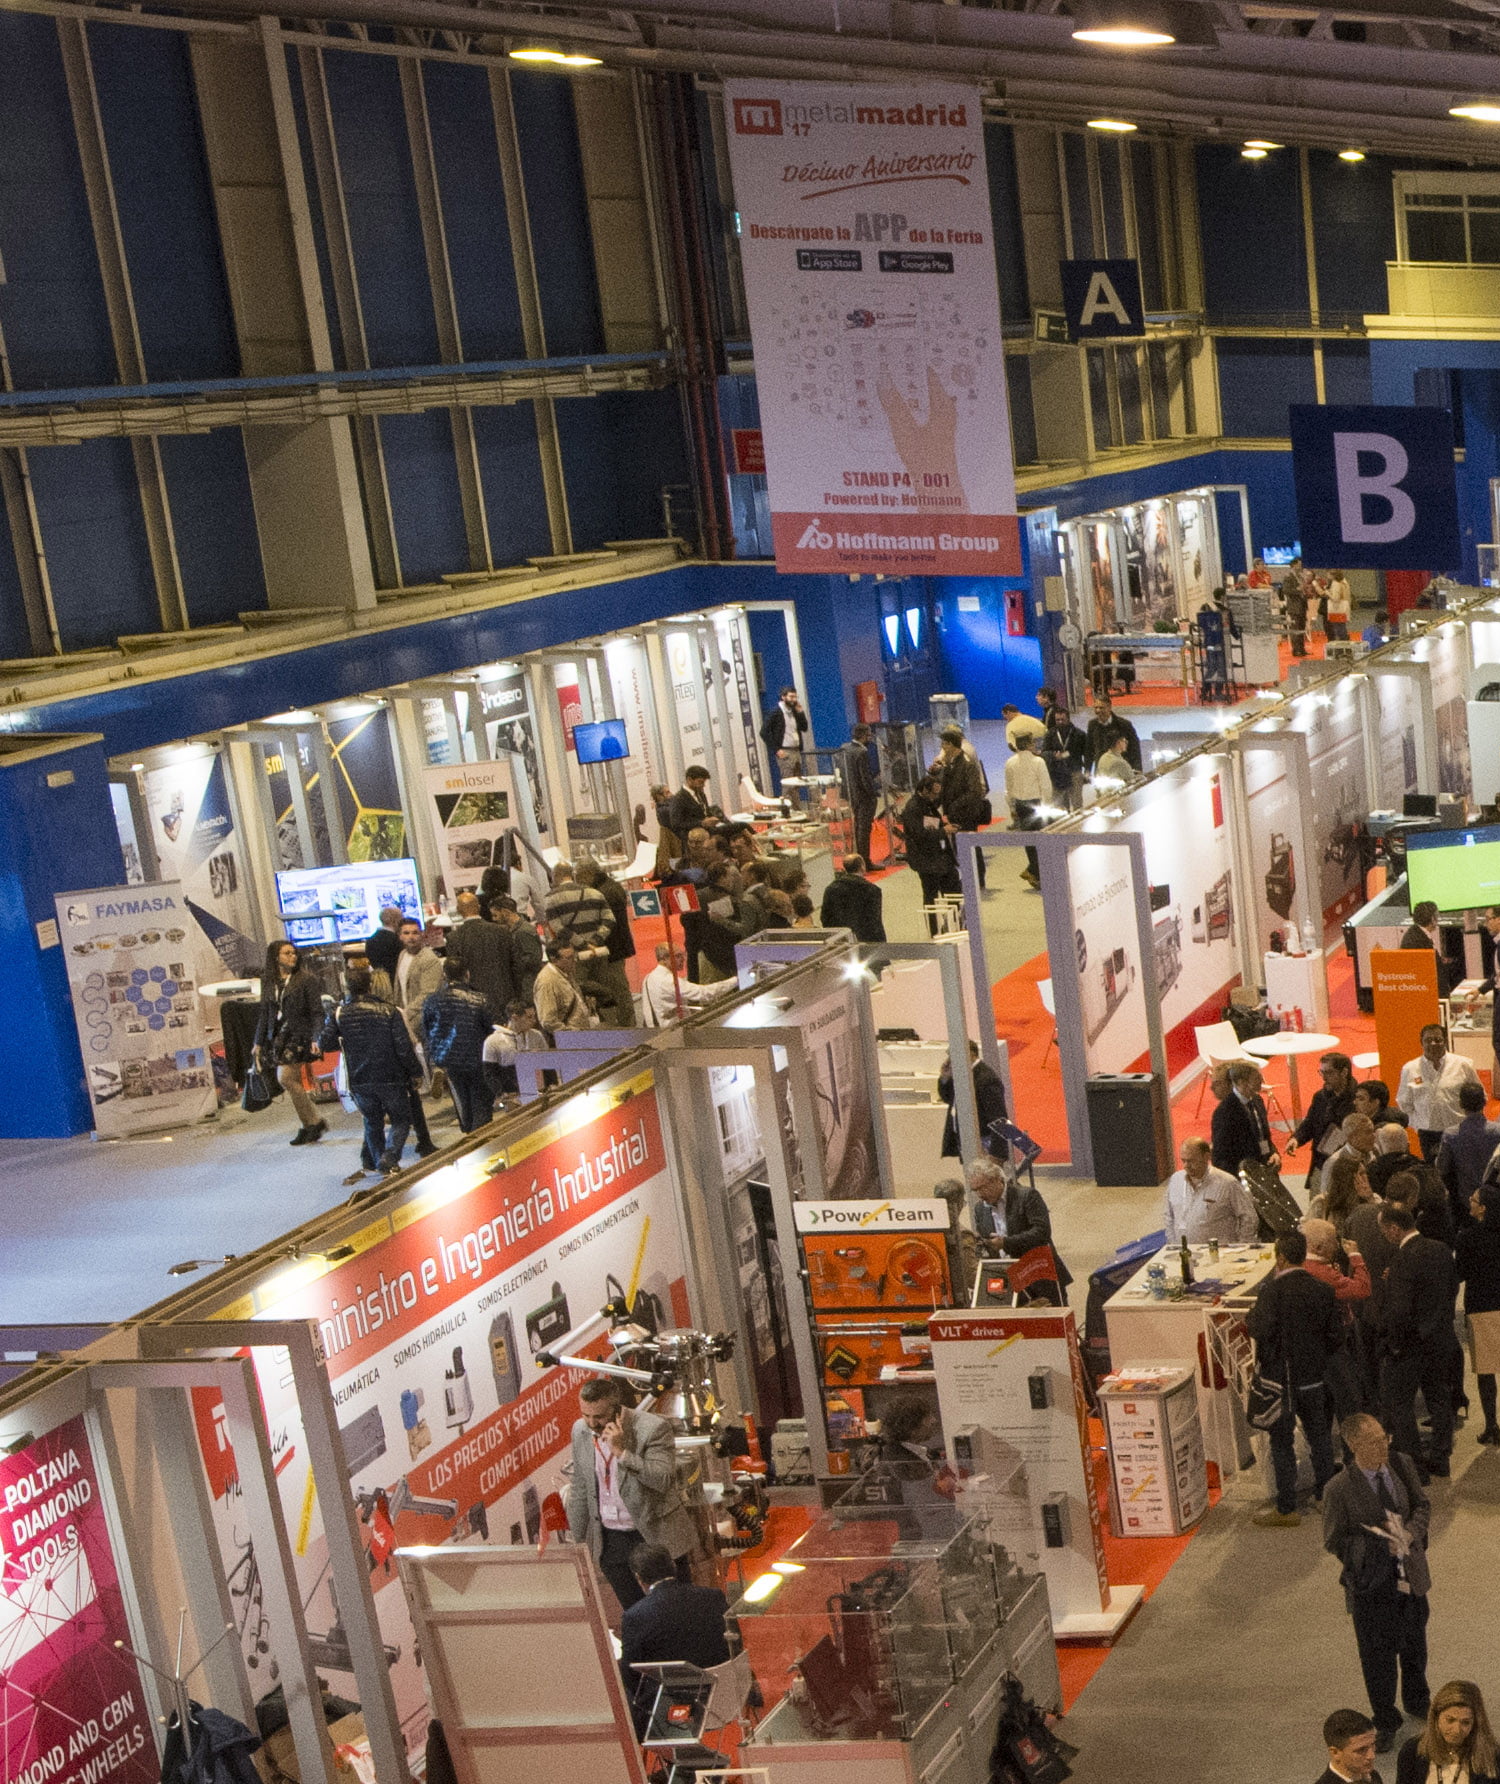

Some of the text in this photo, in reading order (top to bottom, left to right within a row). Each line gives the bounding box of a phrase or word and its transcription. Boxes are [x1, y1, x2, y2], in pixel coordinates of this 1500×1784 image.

[861, 146, 978, 177] Aniversario
[750, 212, 983, 245] Descárgate la APP de la Feria
[1080, 271, 1132, 326] A
[823, 491, 962, 508] Powered by: Hoffmann
[842, 471, 950, 488] STAND P4 D01
[1331, 431, 1418, 544] B
[836, 530, 1000, 553] Hoffmann Group
[94, 895, 177, 921] FAYMASA
[1376, 970, 1418, 985] Bystronic
[1377, 981, 1398, 993] Best
[420, 1253, 438, 1298] e
[437, 1178, 554, 1285] Ingeniería
[553, 1118, 650, 1205] Industrial
[885, 1206, 935, 1225] Team
[392, 1342, 422, 1369] SOMOS
[422, 1310, 468, 1355] HIDRÁULICA
[476, 1289, 502, 1315] SOMOS
[501, 1257, 549, 1300] ELECTRÓNICA
[558, 1234, 582, 1261] SOMOS
[582, 1197, 641, 1251] INSTRUMENTACIÓN
[971, 1325, 1006, 1338] drives
[427, 1458, 453, 1494] LOS
[453, 1429, 504, 1477] PRECIOS
[513, 1377, 568, 1438] SERVICIOS
[5, 1446, 82, 1510] POLTAVA
[478, 1422, 561, 1496] COMPETITIVOS
[11, 1478, 92, 1547] DIAMOND
[19, 1522, 80, 1581] TOOLS
[68, 1718, 101, 1760] AND
[101, 1690, 136, 1733] CBN
